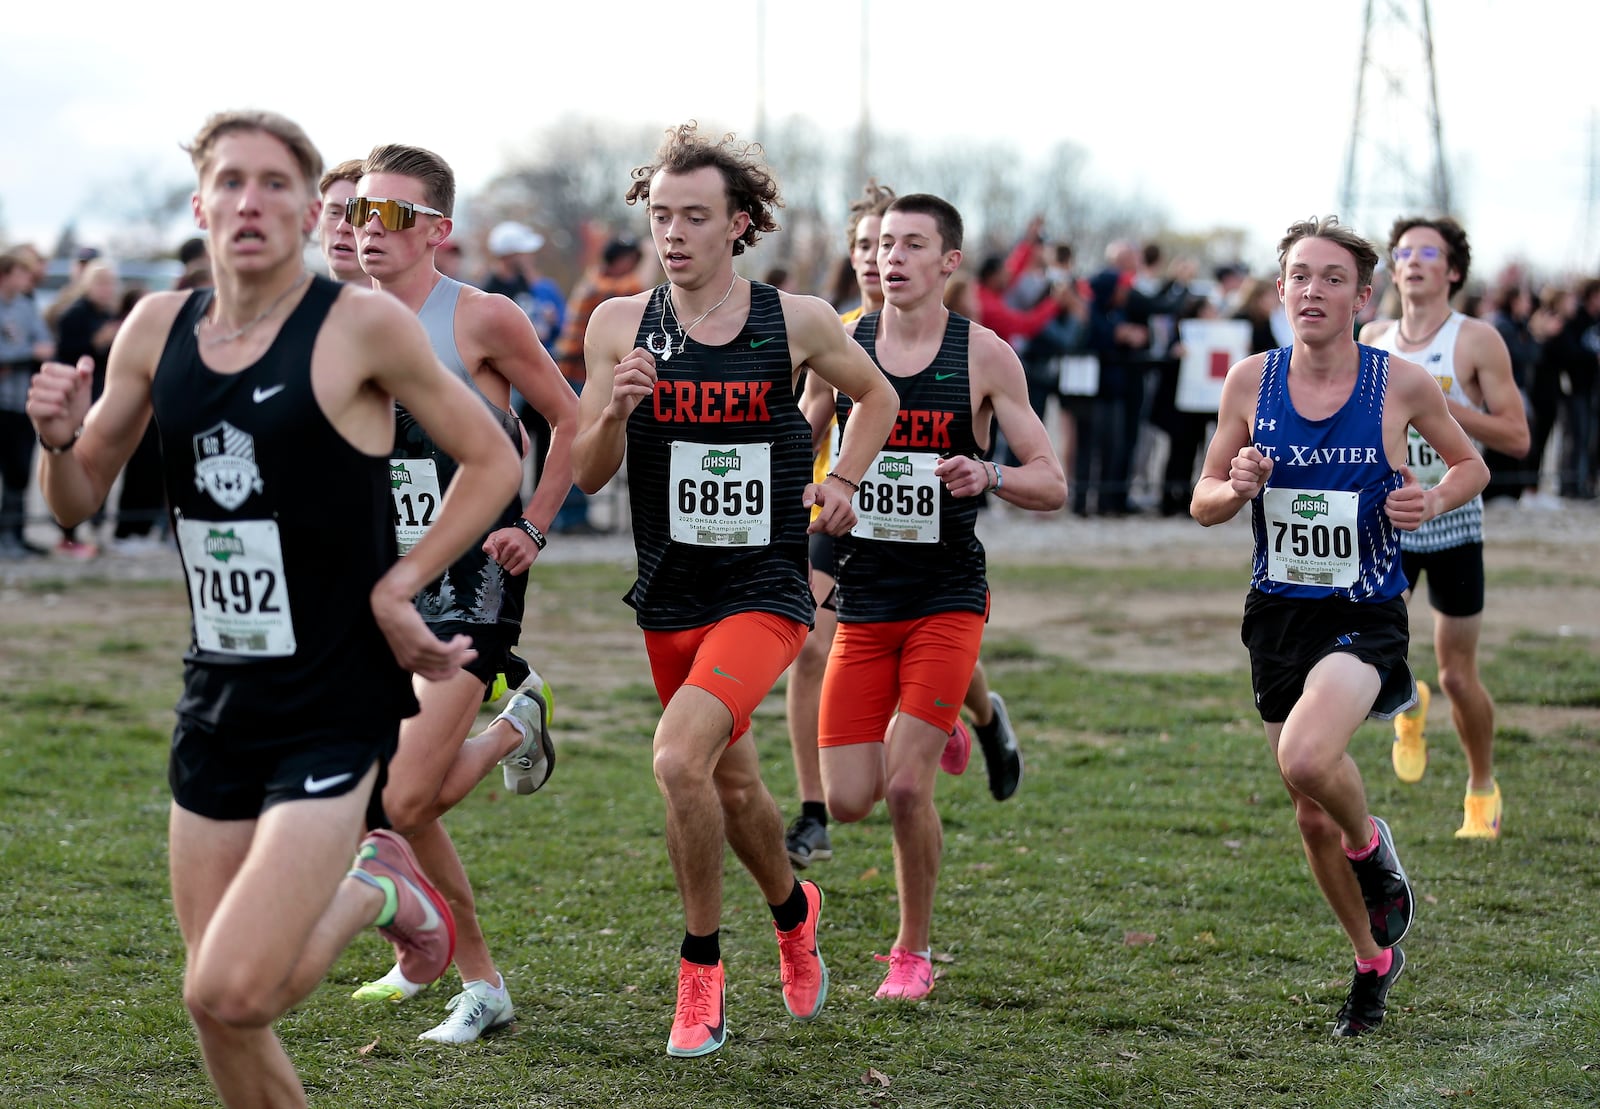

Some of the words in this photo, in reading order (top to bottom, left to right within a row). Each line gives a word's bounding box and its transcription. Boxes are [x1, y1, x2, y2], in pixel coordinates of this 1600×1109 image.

[653, 381, 772, 423] CREEK
[848, 409, 954, 448] EEK
[703, 456, 740, 468] OHSAA
[1287, 445, 1378, 466] XAVIER
[880, 462, 912, 474] OHSAA
[679, 478, 764, 516] 6859
[858, 480, 934, 516] 6858
[1293, 500, 1328, 513] OHSAA
[679, 515, 694, 523] 2025
[694, 517, 717, 525] OHSAA
[707, 525, 752, 533] Championship
[1272, 521, 1352, 559] 7500
[1300, 565, 1342, 573] Championship
[193, 566, 281, 614] 7492
